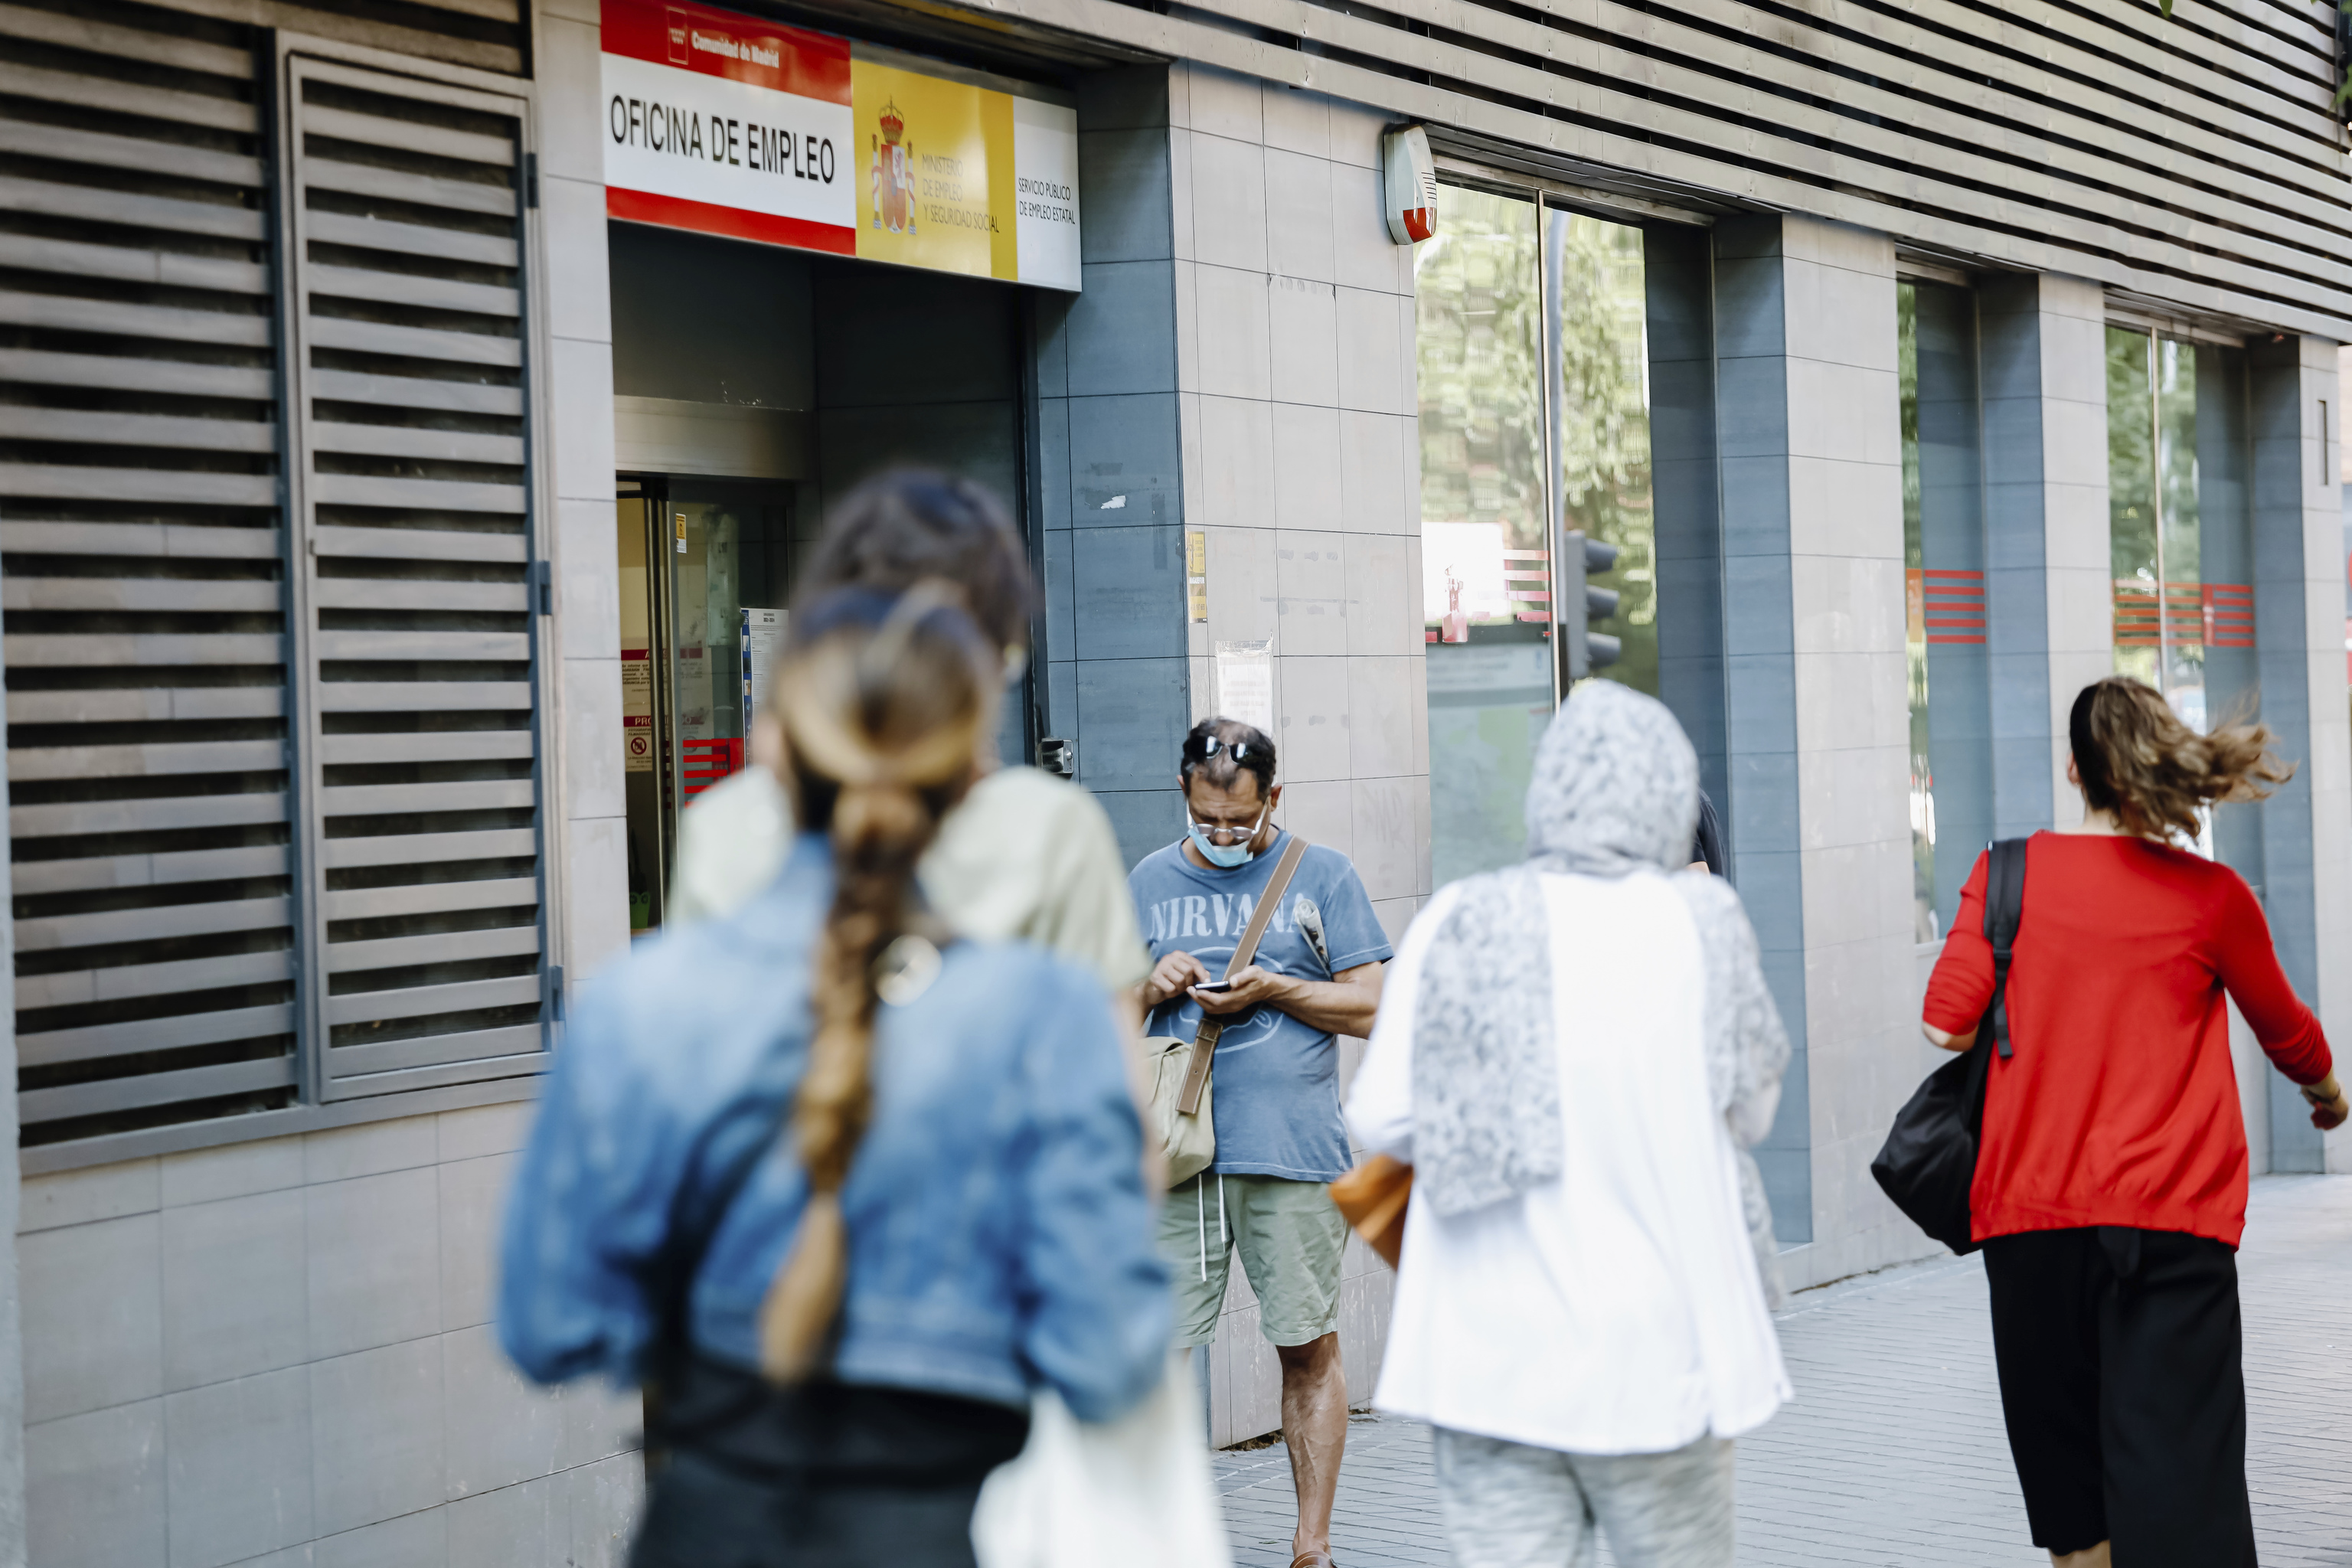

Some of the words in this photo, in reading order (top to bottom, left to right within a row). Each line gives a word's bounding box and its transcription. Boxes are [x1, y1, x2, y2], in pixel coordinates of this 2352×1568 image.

[691, 30, 739, 59] Comunidad
[740, 43, 750, 61] de
[751, 44, 779, 69] Madrid
[611, 95, 704, 159] OFICINA
[711, 116, 740, 165] DE
[748, 123, 835, 184] EMPLEO
[922, 154, 964, 178] MINISTERIO
[923, 178, 933, 197] DE
[935, 180, 963, 202] EMPLEO
[1018, 177, 1044, 196] SERVICIO
[1045, 179, 1071, 201] PÚBLICO
[923, 203, 929, 220] Y
[930, 204, 972, 228] SEGURIDAD
[973, 211, 999, 233] SOCIAL
[1019, 201, 1027, 215] DE
[1029, 203, 1051, 220] EMPLEO
[1053, 207, 1076, 224] ESTATAL
